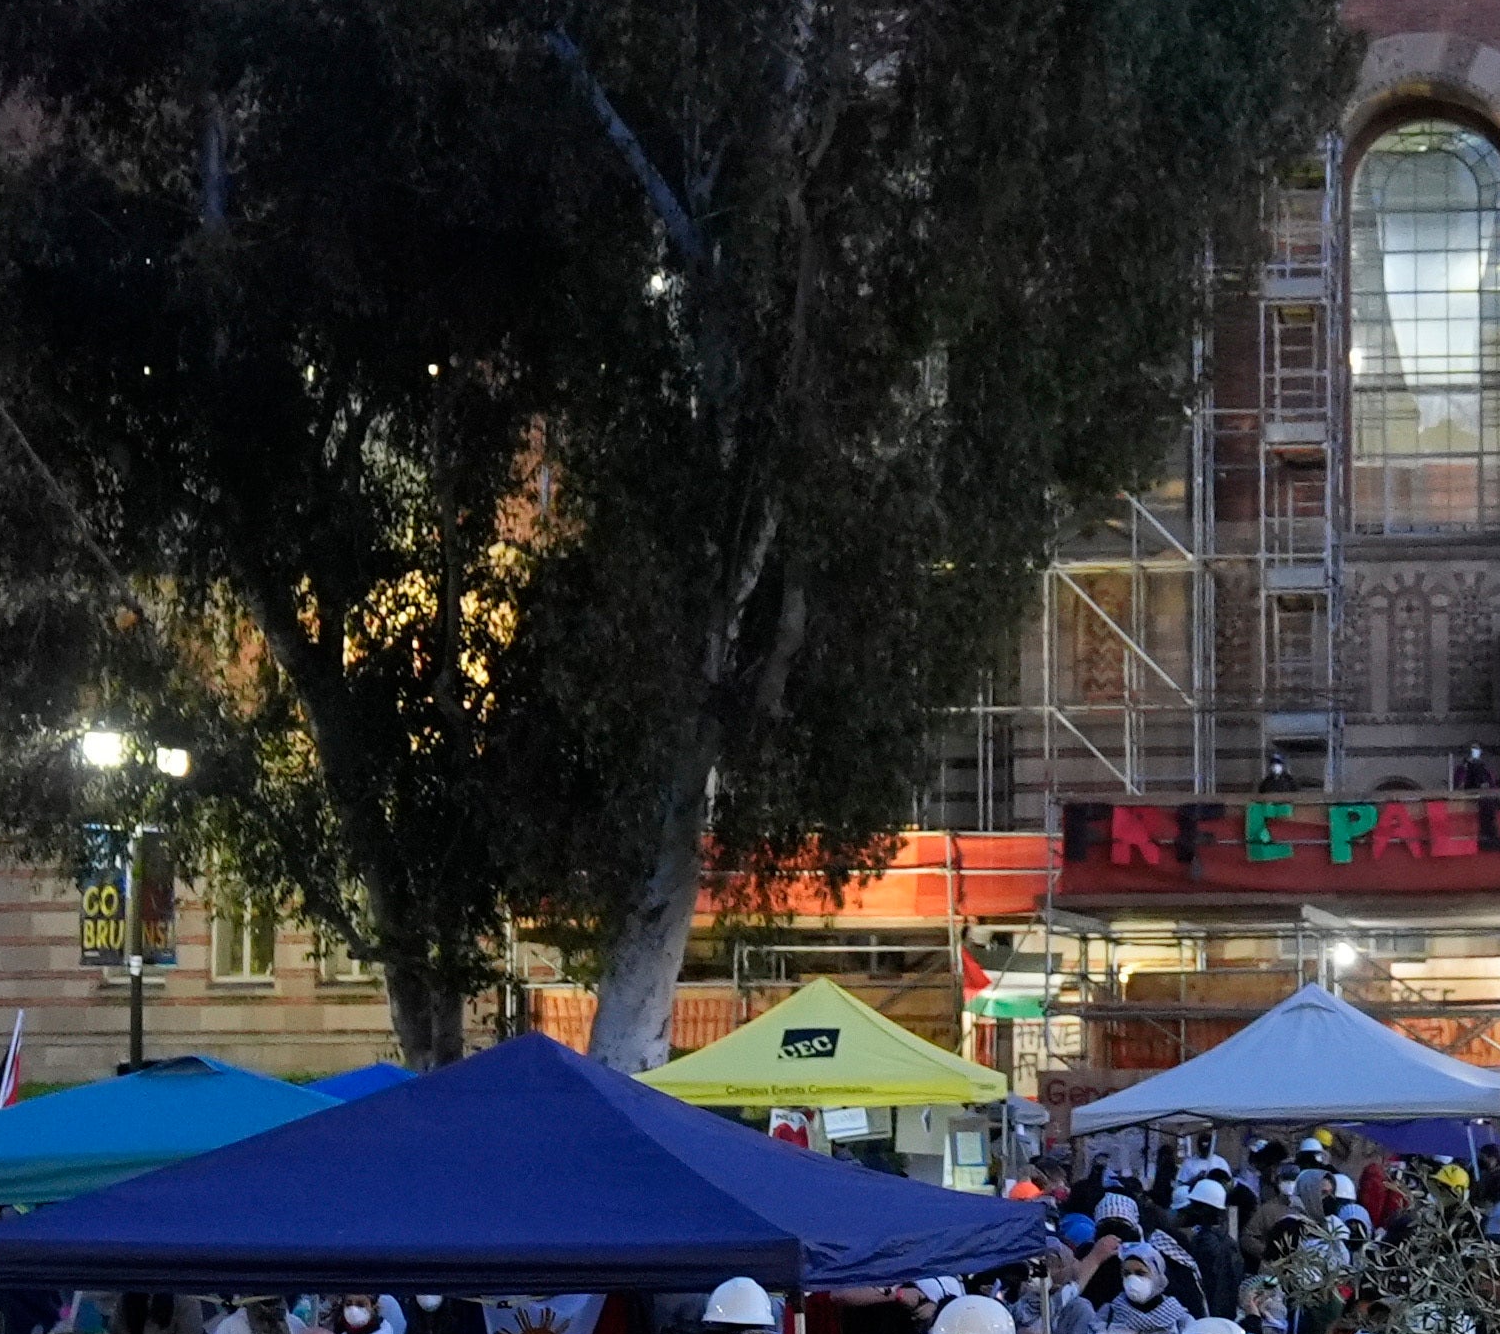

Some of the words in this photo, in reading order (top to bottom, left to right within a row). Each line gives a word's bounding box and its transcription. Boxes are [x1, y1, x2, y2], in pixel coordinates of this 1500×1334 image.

[1063, 800, 1294, 868] FREE
[83, 885, 119, 916] GO
[781, 1034, 833, 1060] CEC
